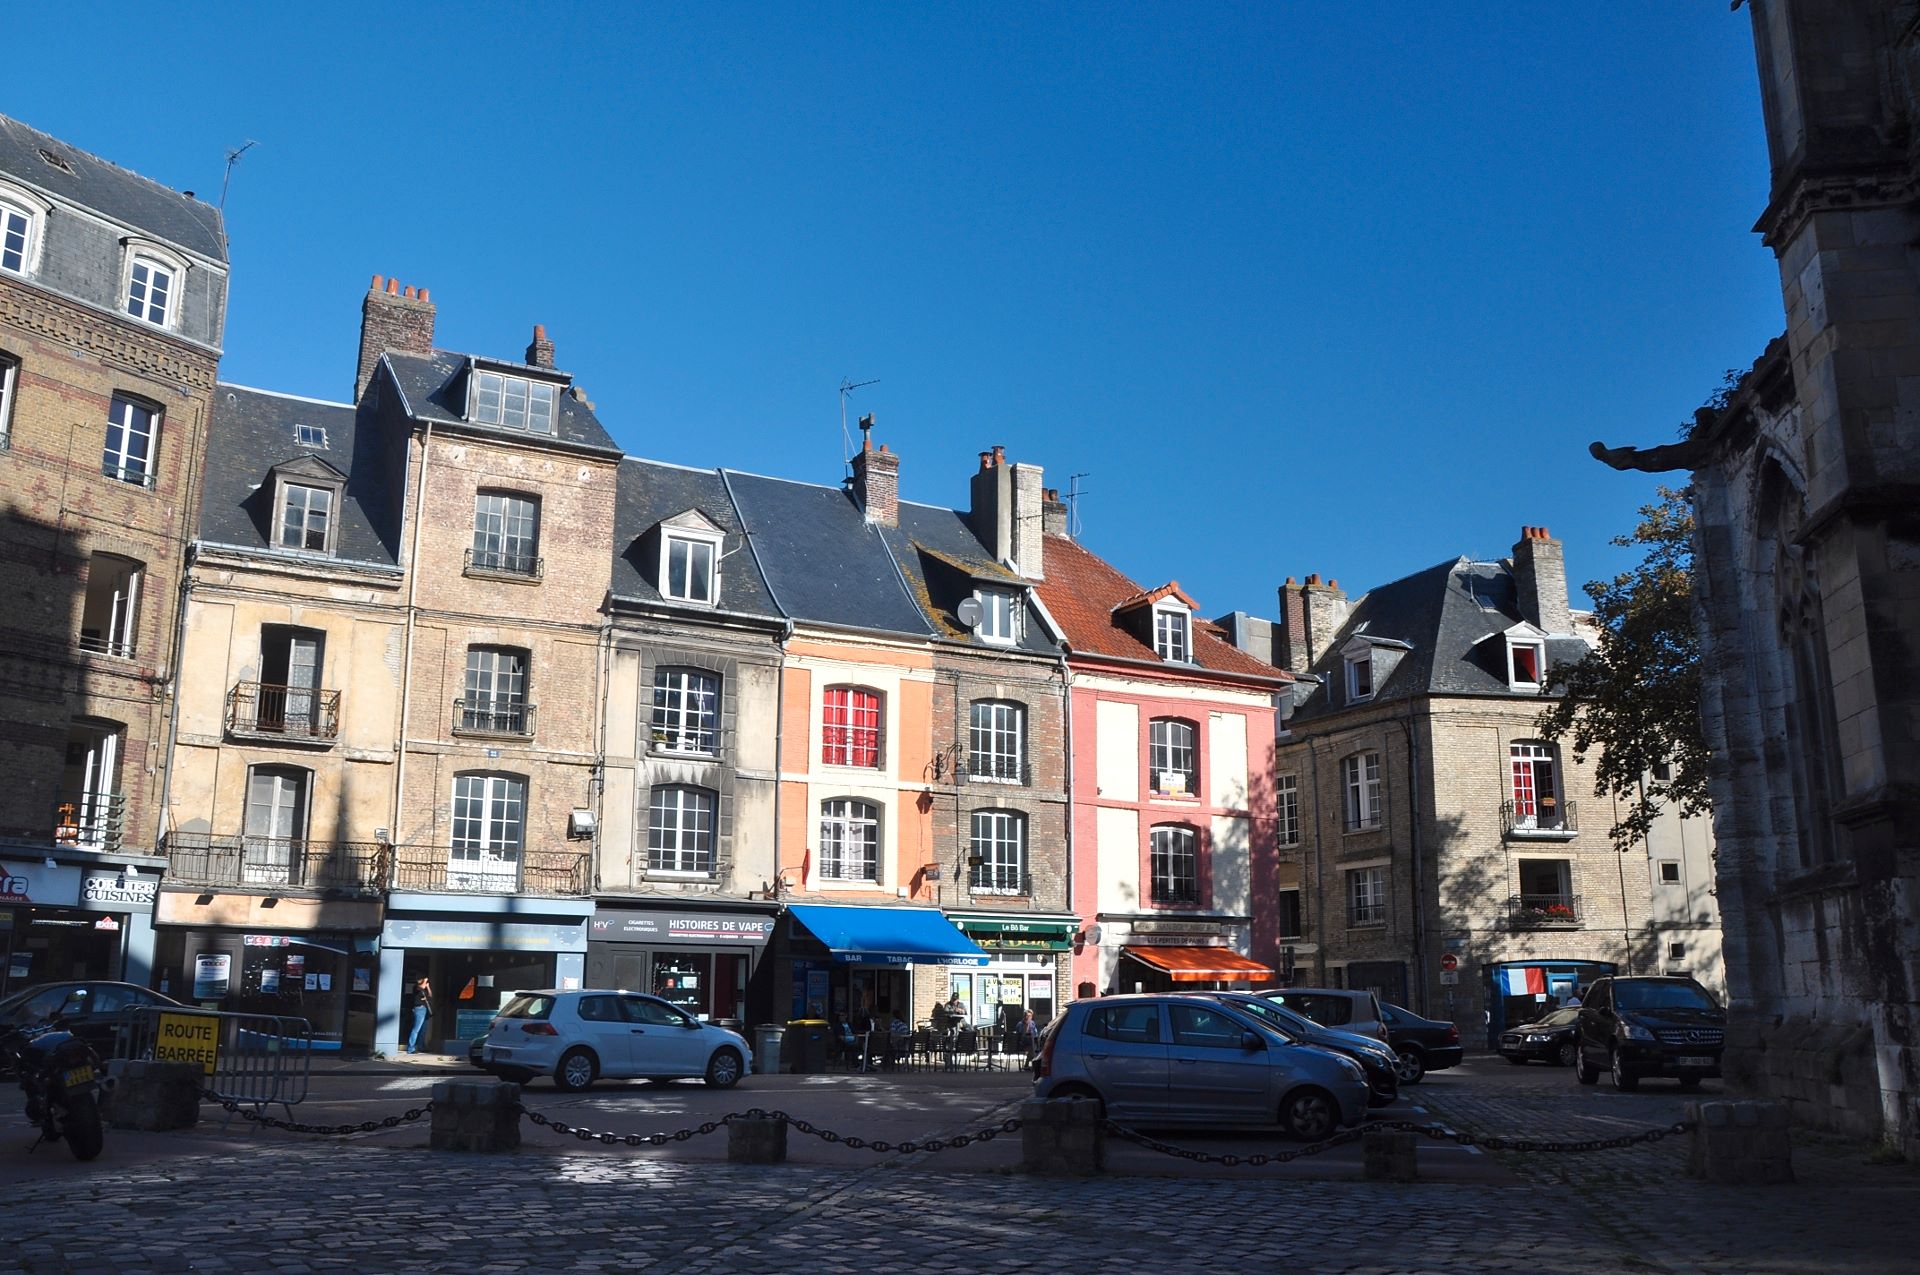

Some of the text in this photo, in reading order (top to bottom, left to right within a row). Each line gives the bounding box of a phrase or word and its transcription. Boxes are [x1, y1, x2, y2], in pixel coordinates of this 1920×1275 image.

[84, 889, 154, 903] CUISINES
[669, 919, 763, 932] HISTOIRES DE VAPE
[845, 954, 862, 962] BAR
[887, 955, 913, 963] TABAC
[165, 1024, 211, 1040] ROUTE
[157, 1046, 214, 1064] BARRÉE
